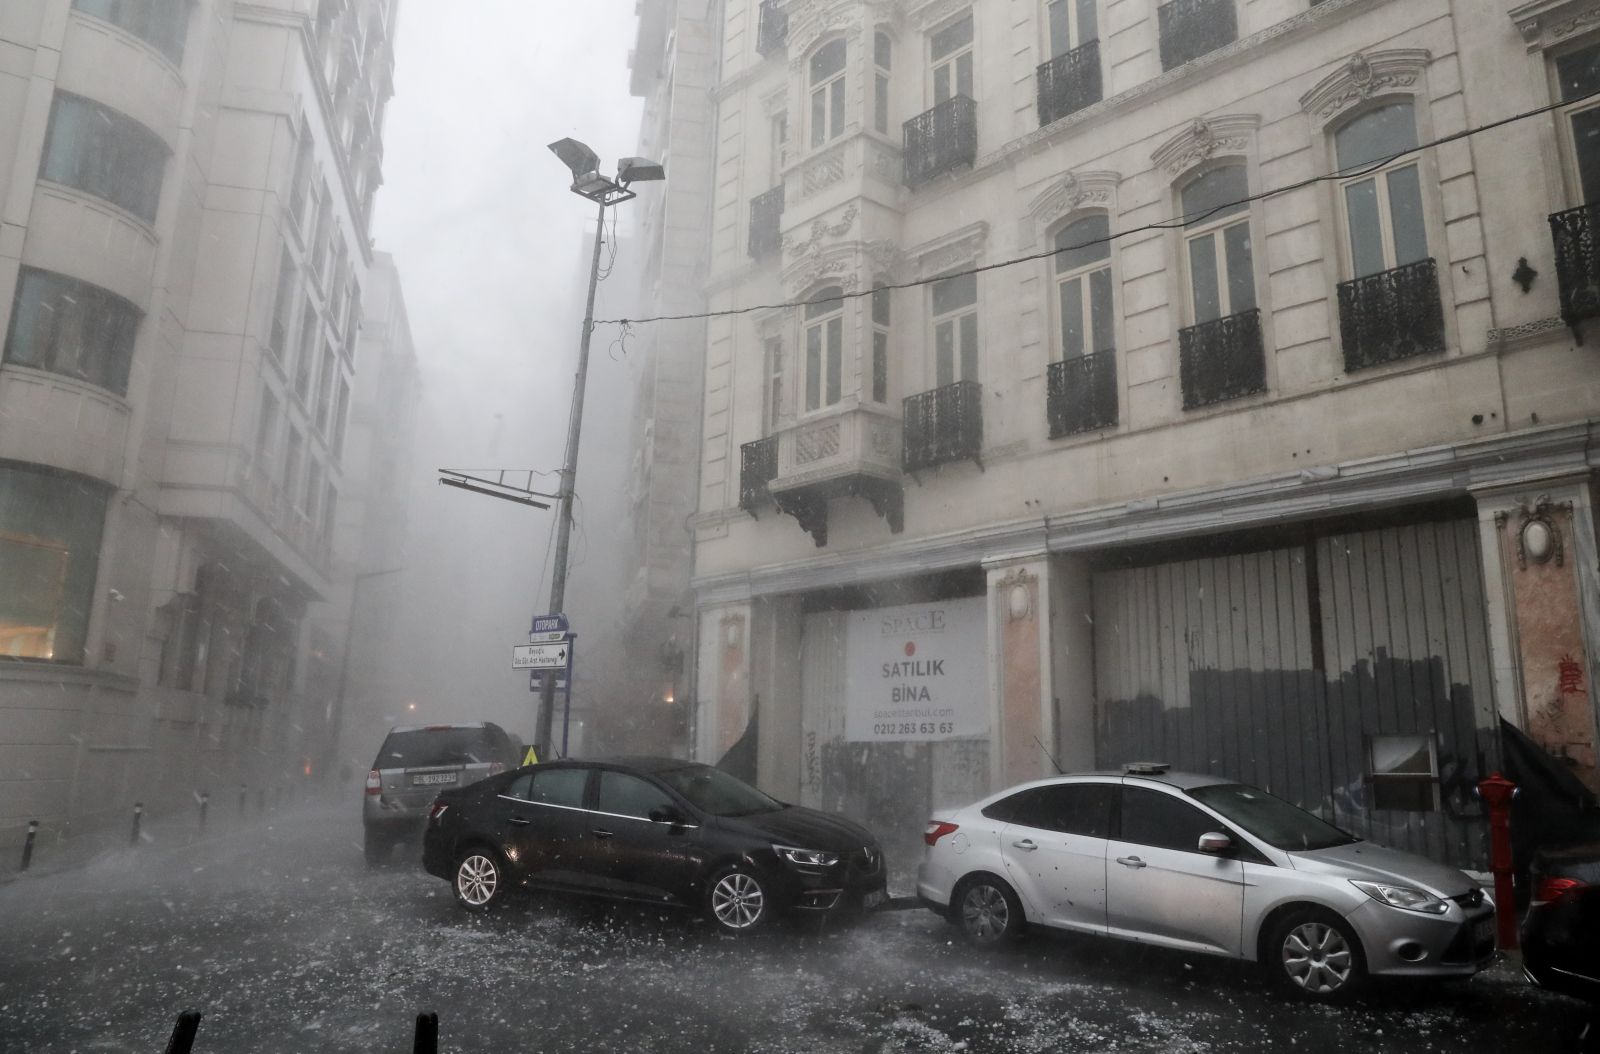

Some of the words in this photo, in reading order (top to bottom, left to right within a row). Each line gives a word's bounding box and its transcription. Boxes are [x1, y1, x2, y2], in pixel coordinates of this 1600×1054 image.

[535, 619, 559, 631] OTOPARK
[881, 609, 945, 634] SPACE
[882, 659, 945, 678] SATILIK
[891, 683, 931, 703] BİNA
[874, 723, 896, 735] 0212
[898, 722, 917, 734] 263
[920, 722, 935, 734] 63
[939, 722, 954, 734] 63
